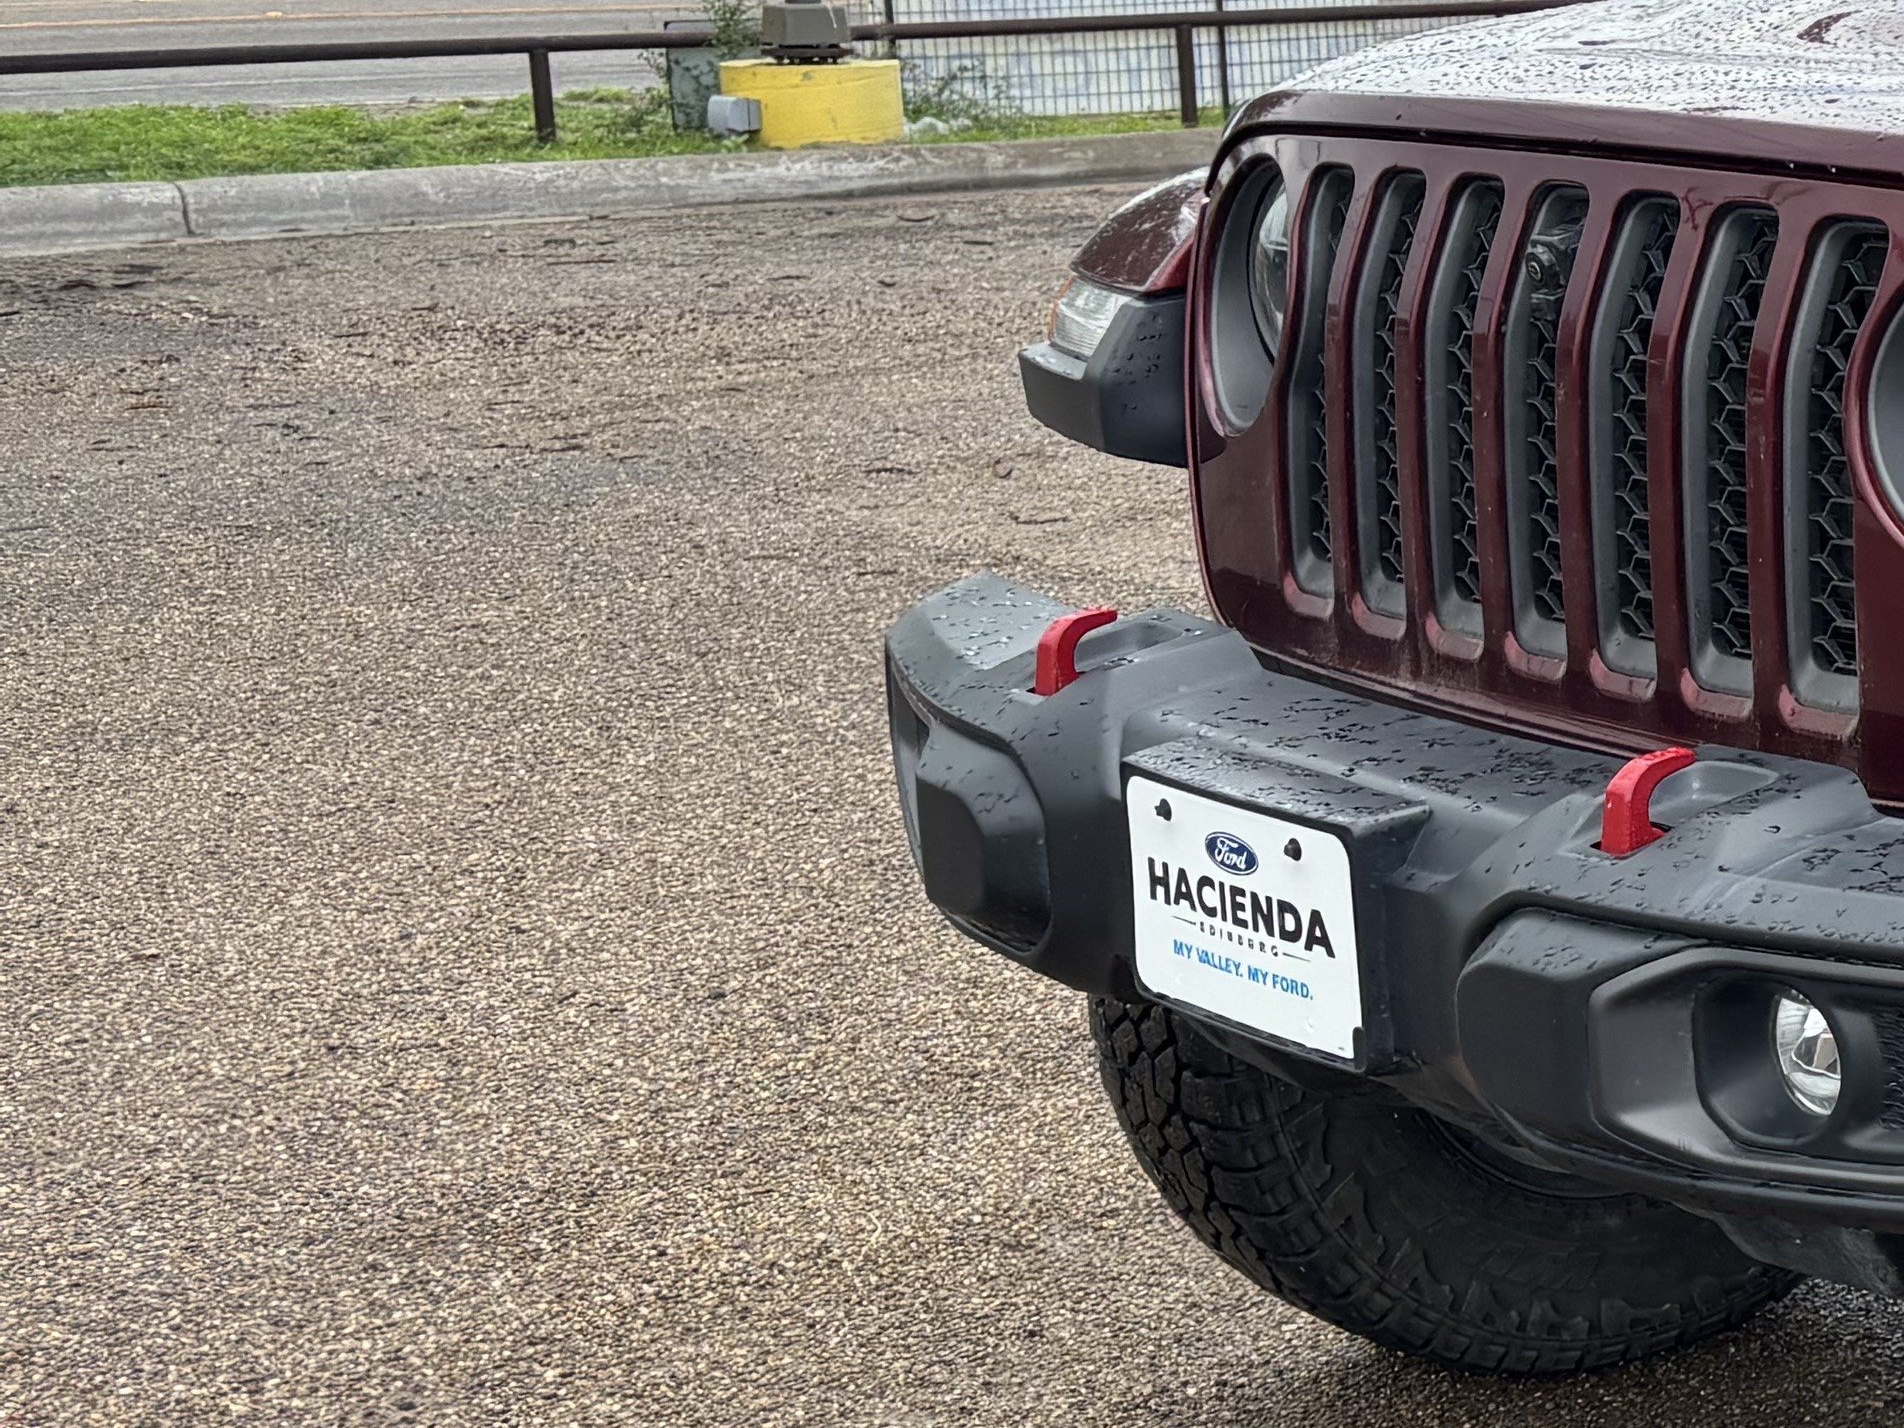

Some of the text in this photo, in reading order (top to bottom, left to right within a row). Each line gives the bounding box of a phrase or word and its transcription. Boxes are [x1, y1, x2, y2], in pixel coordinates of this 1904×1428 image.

[1214, 837, 1248, 872] Ford
[1147, 856, 1337, 959] HACIENDA
[1173, 939, 1314, 1001] MY VALLEY. MY FORD.
